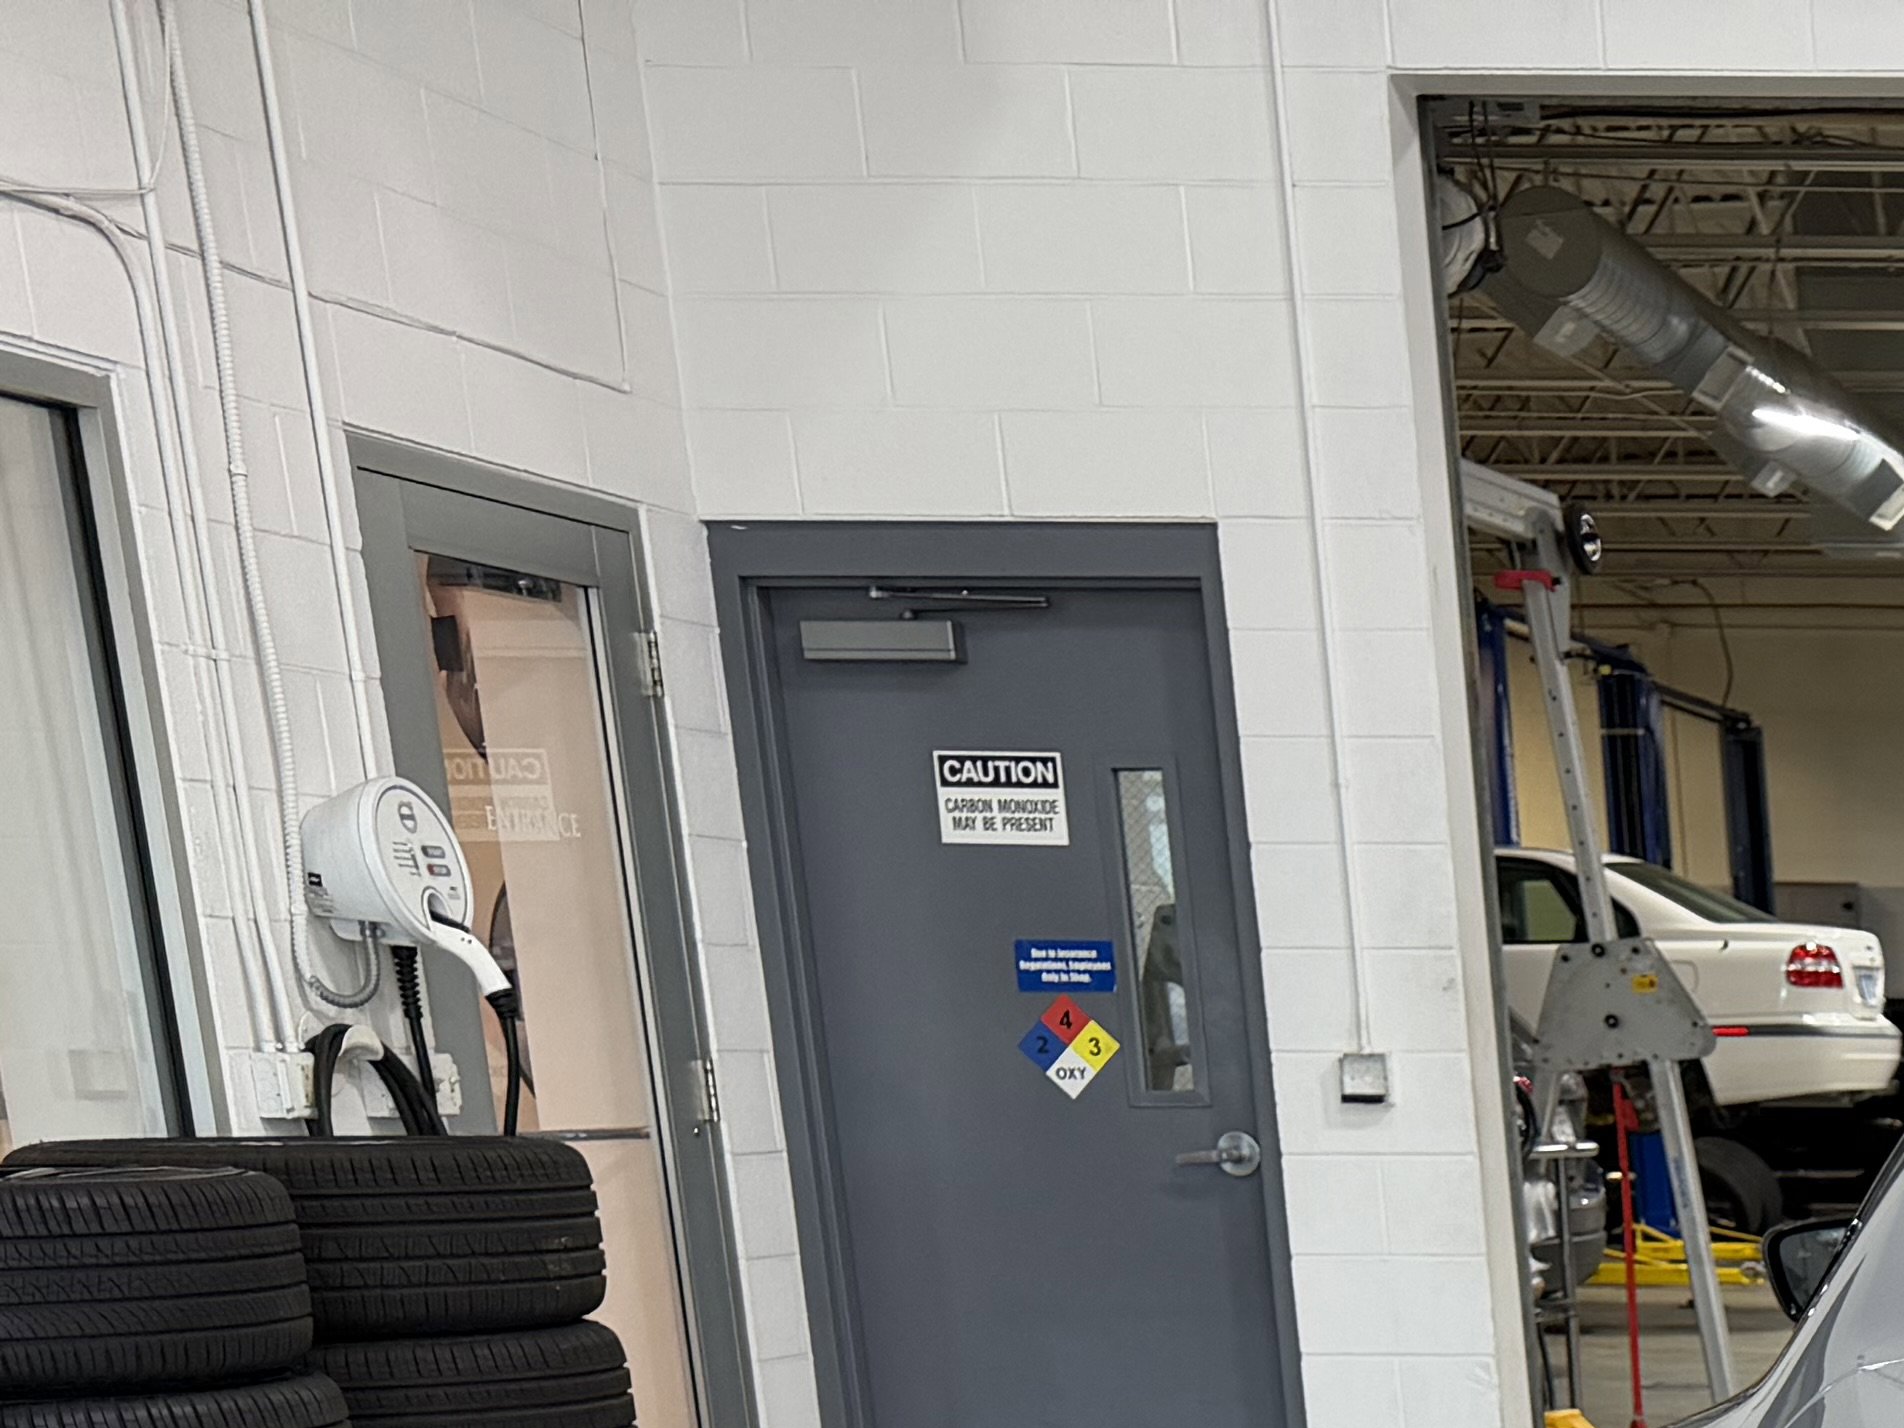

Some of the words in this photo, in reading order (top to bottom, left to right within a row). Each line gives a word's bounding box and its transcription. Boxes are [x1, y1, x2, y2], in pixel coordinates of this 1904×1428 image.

[943, 759, 1055, 785] CAUTION
[945, 797, 993, 815] CARBON
[997, 798, 1059, 816] MONOXIDE
[484, 803, 581, 838] ENTRANCE
[952, 816, 977, 832] MAY
[982, 816, 998, 832] BE
[1002, 817, 1055, 833] PRESENT
[1059, 1009, 1073, 1030] 4
[1036, 1036, 1049, 1054] 2
[1088, 1037, 1102, 1057] 3
[1055, 1066, 1088, 1081] OXY
